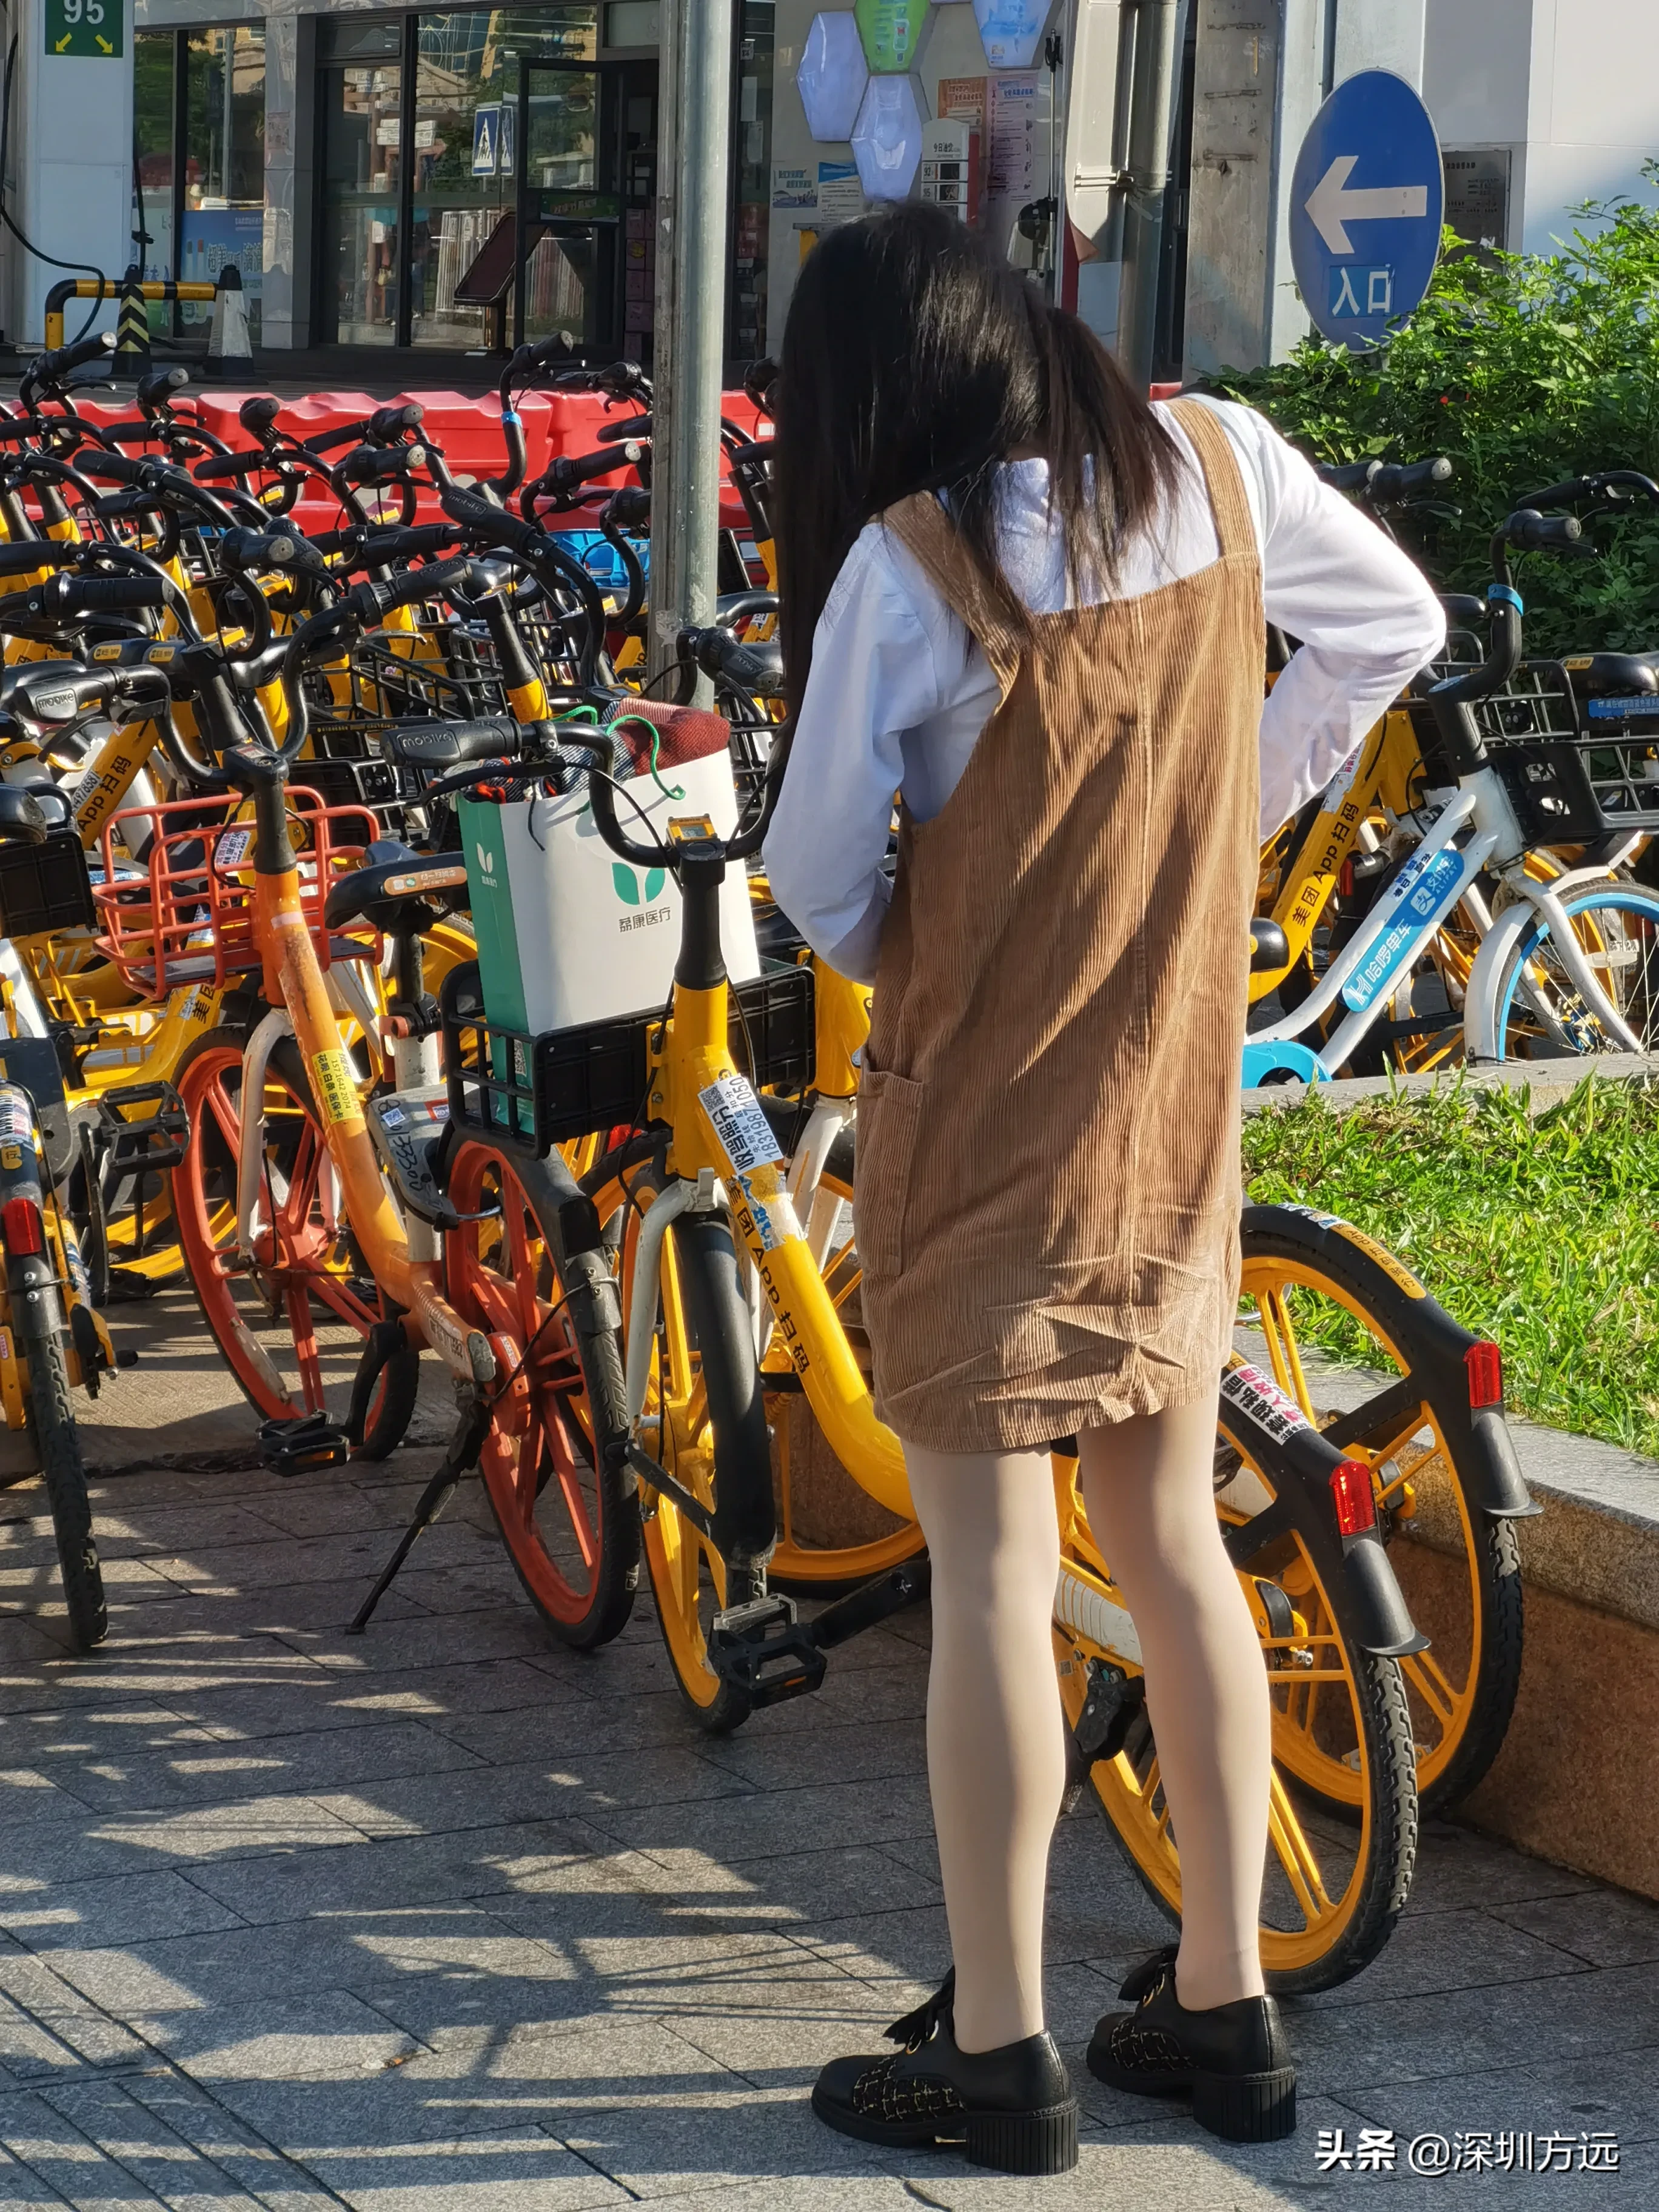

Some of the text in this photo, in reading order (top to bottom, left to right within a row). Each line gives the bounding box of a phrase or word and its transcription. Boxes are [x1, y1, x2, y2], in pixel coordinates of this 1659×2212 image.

[63, 0, 105, 24] 95
[1332, 267, 1392, 316] 入口
[401, 732, 452, 748] mobike
[77, 755, 132, 832] App 扫码
[1292, 888, 1320, 928] 美团
[1314, 845, 1338, 883] App
[1330, 801, 1360, 843] 扫码
[1427, 855, 1456, 891] 支付宝
[618, 906, 671, 933] 荔康医疗
[1367, 919, 1413, 984] 哈啰单车
[712, 1105, 756, 1171] 收驾照分
[729, 1076, 780, 1158] 18319871050
[1346, 1230, 1371, 1245] App
[751, 1245, 780, 1305] App
[779, 1309, 811, 1375] 扫码
